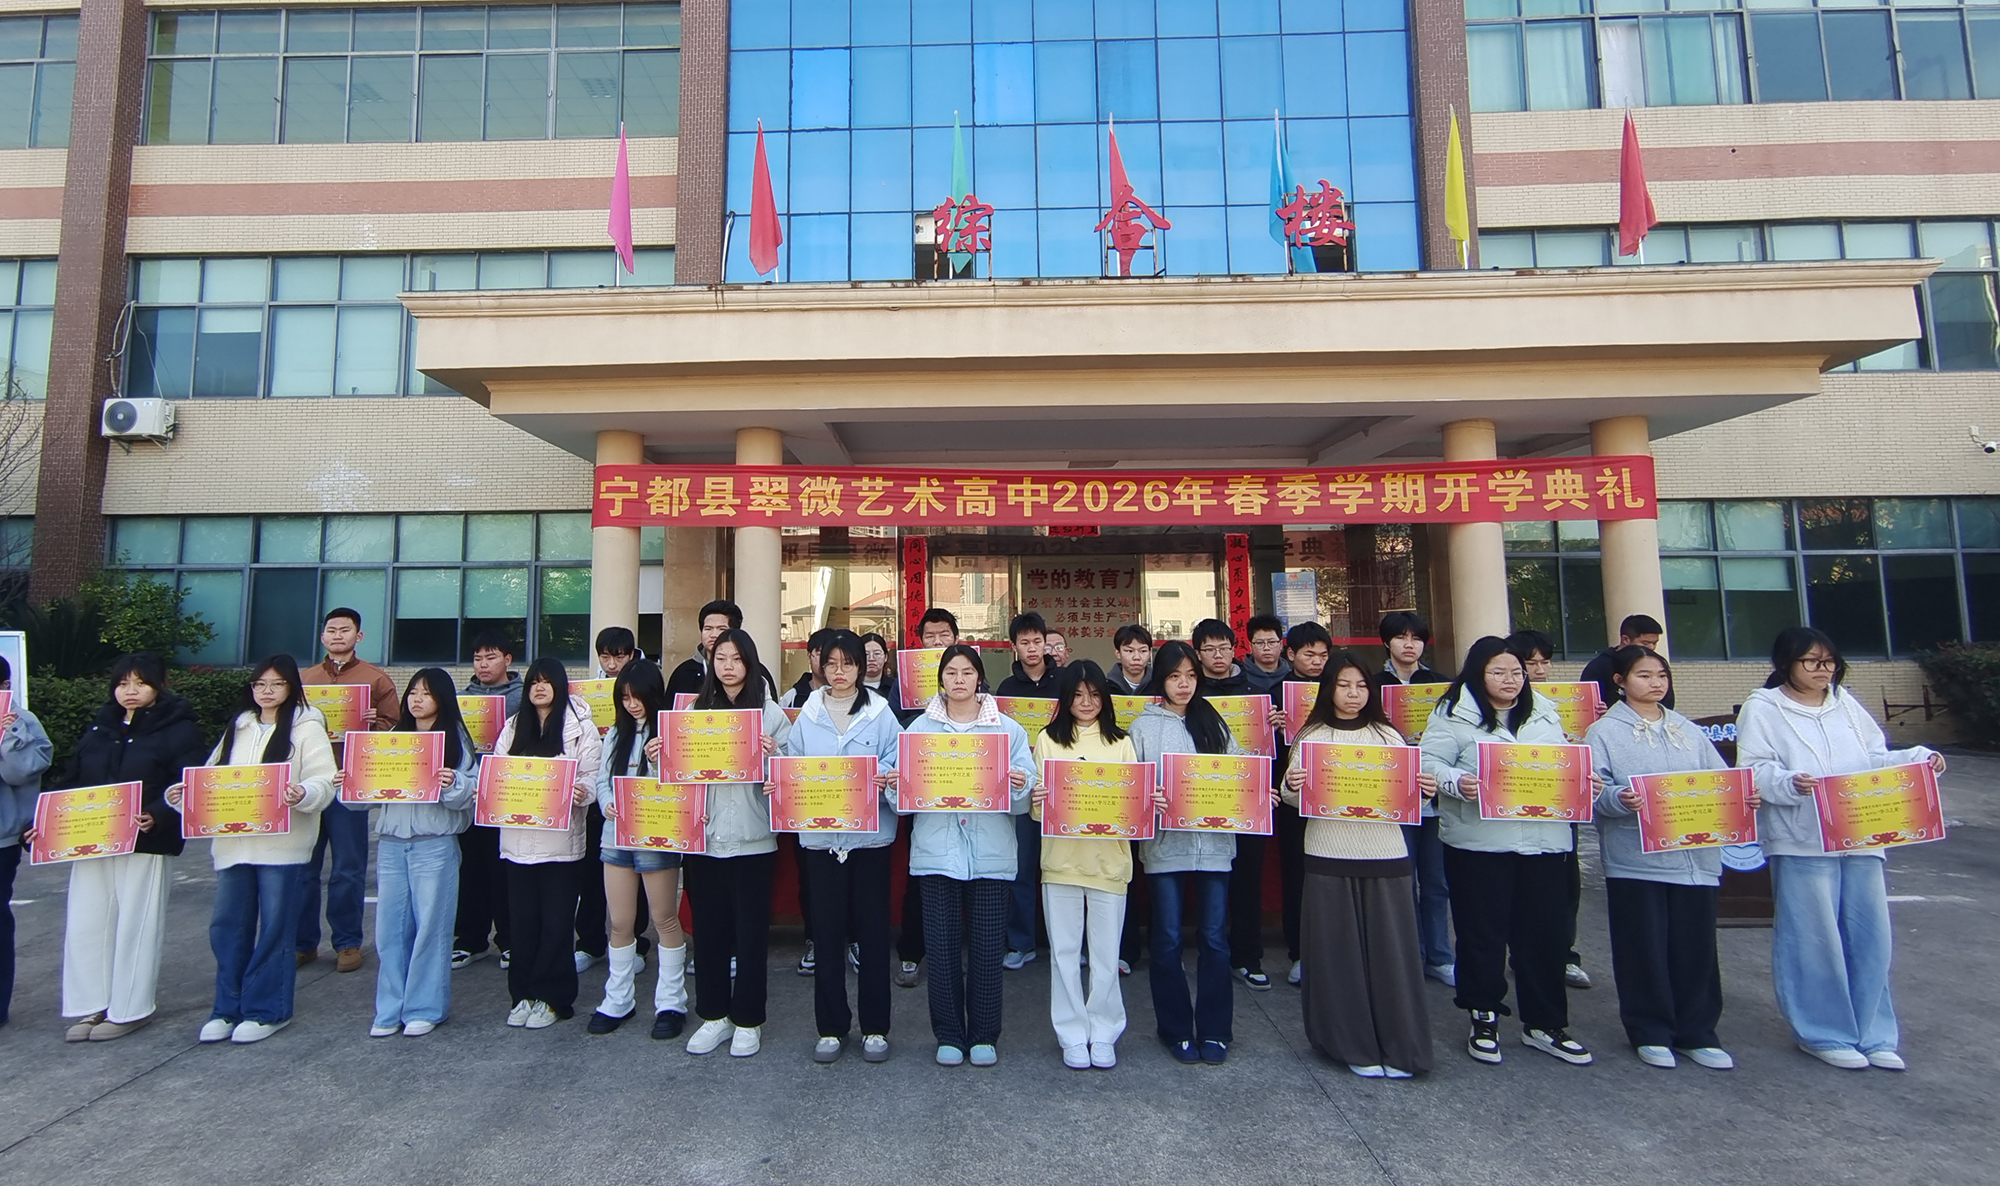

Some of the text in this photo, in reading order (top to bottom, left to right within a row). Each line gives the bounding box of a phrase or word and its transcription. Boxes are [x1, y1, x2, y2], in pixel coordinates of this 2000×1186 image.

[933, 178, 1356, 254] 综合楼
[599, 467, 1646, 518] 宁都县翠微艺术高中2026年春季学期开学典礼
